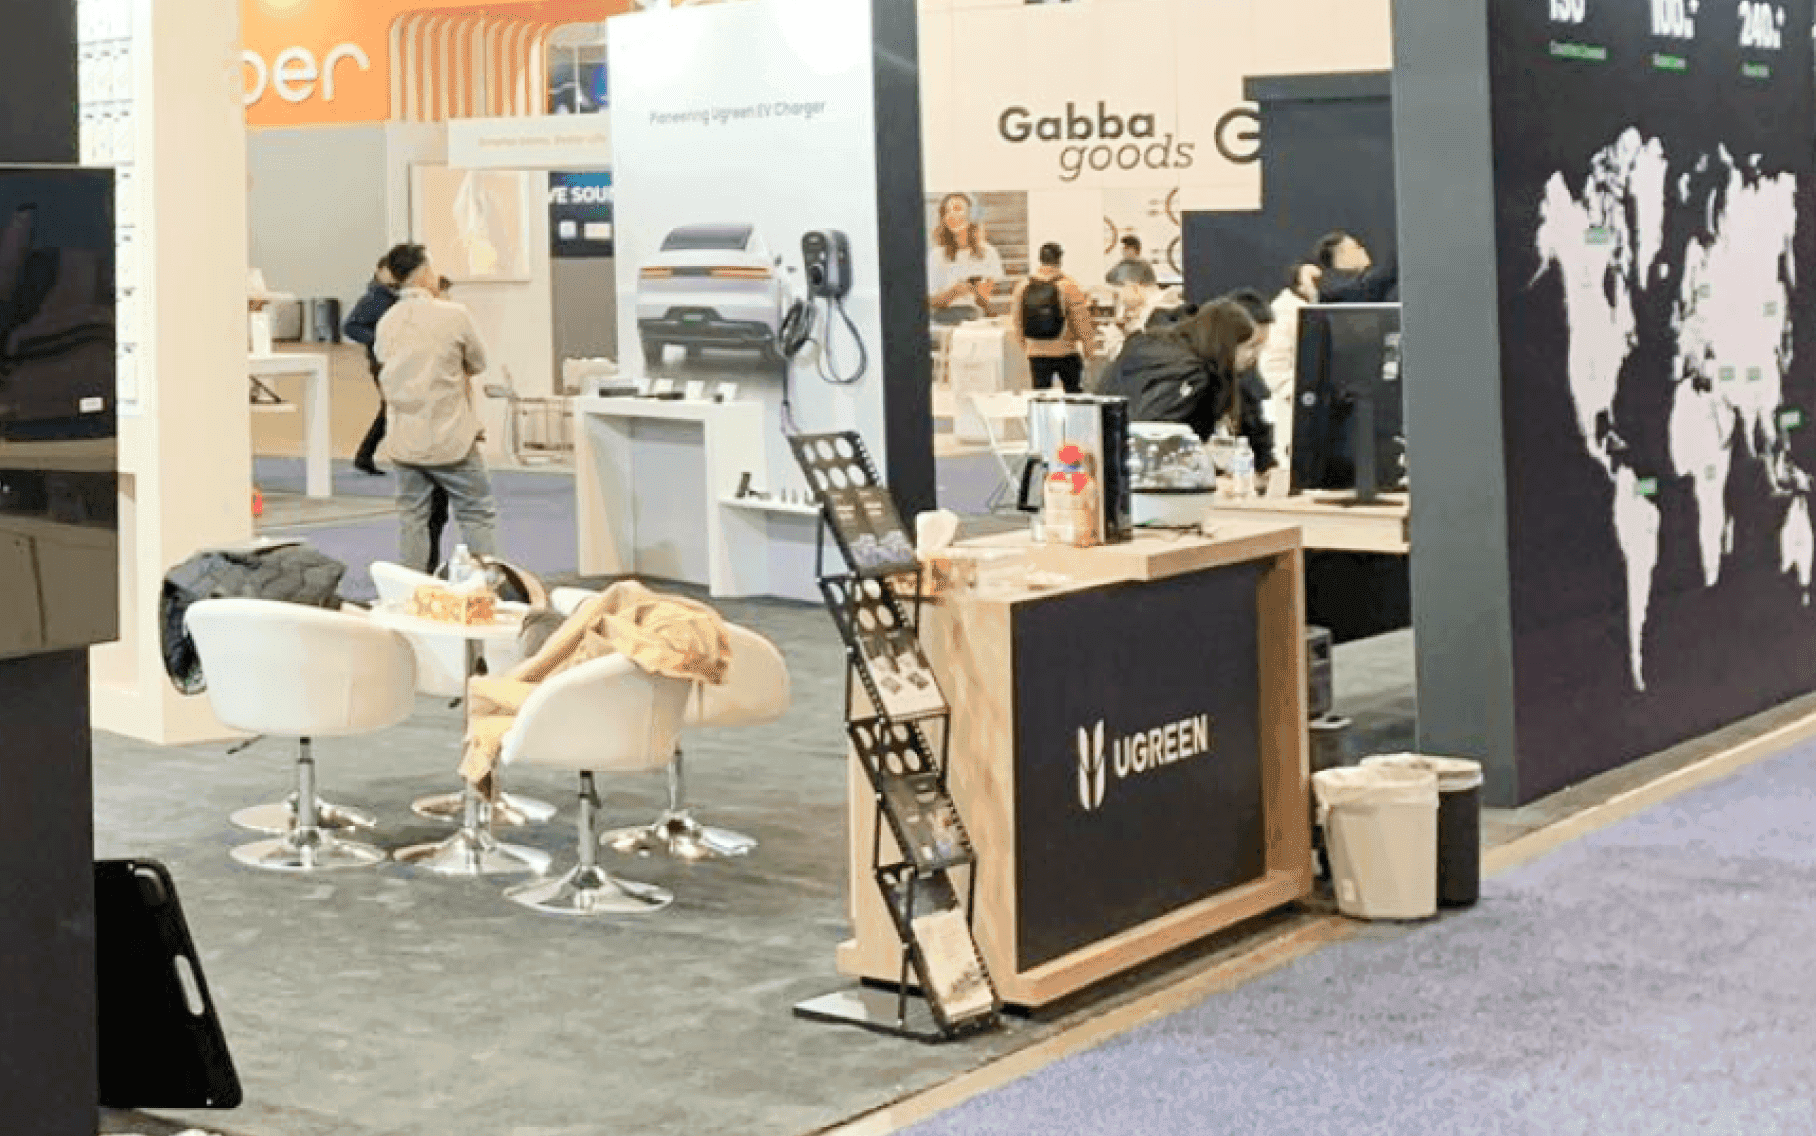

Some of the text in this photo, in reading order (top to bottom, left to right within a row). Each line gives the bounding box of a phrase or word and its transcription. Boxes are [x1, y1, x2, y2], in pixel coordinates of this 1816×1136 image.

[998, 101, 1156, 143] Gabba
[1058, 133, 1195, 182] goods
[571, 184, 613, 206] SOU
[1113, 713, 1209, 779] UGREEN
